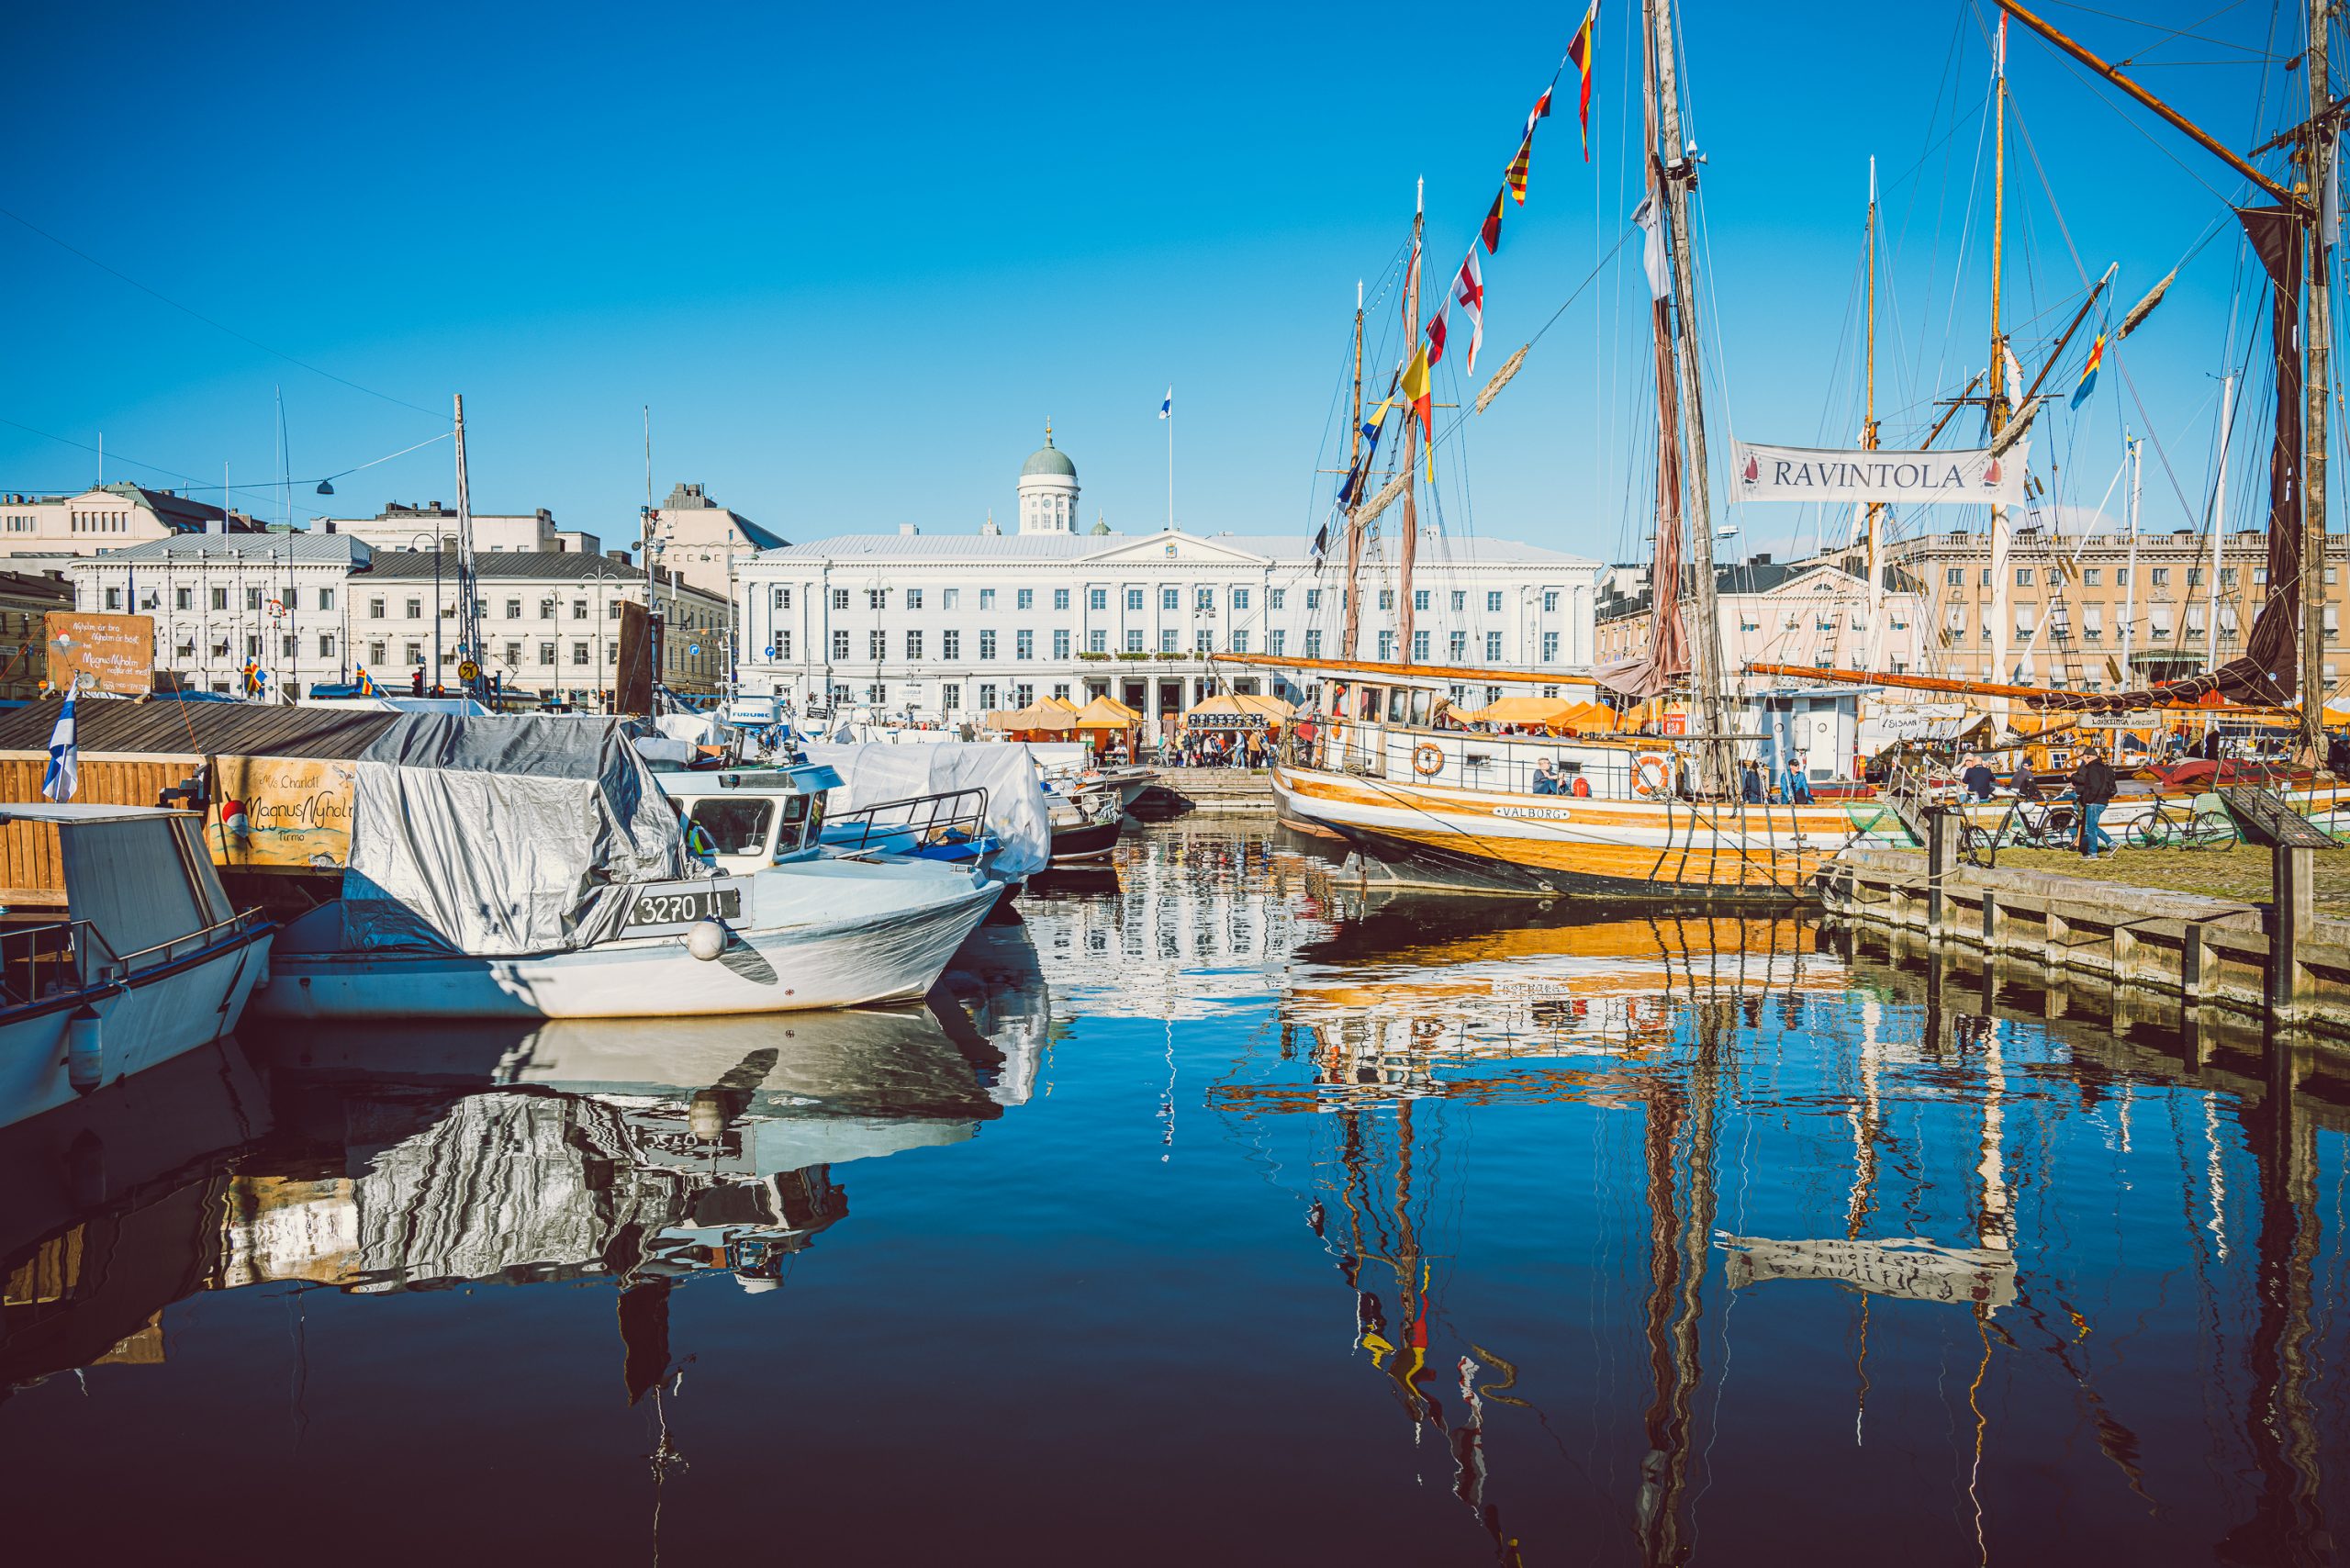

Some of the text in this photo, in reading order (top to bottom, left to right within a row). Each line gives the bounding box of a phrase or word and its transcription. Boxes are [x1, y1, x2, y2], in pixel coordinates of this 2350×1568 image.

[1774, 461, 1965, 488] RAVINTOLA
[83, 652, 139, 669] Magnus Nyholm
[241, 796, 303, 832] Magnus
[1503, 807, 1561, 819] VALBORG
[278, 831, 305, 842] Tirmo
[640, 895, 696, 924] 3270
